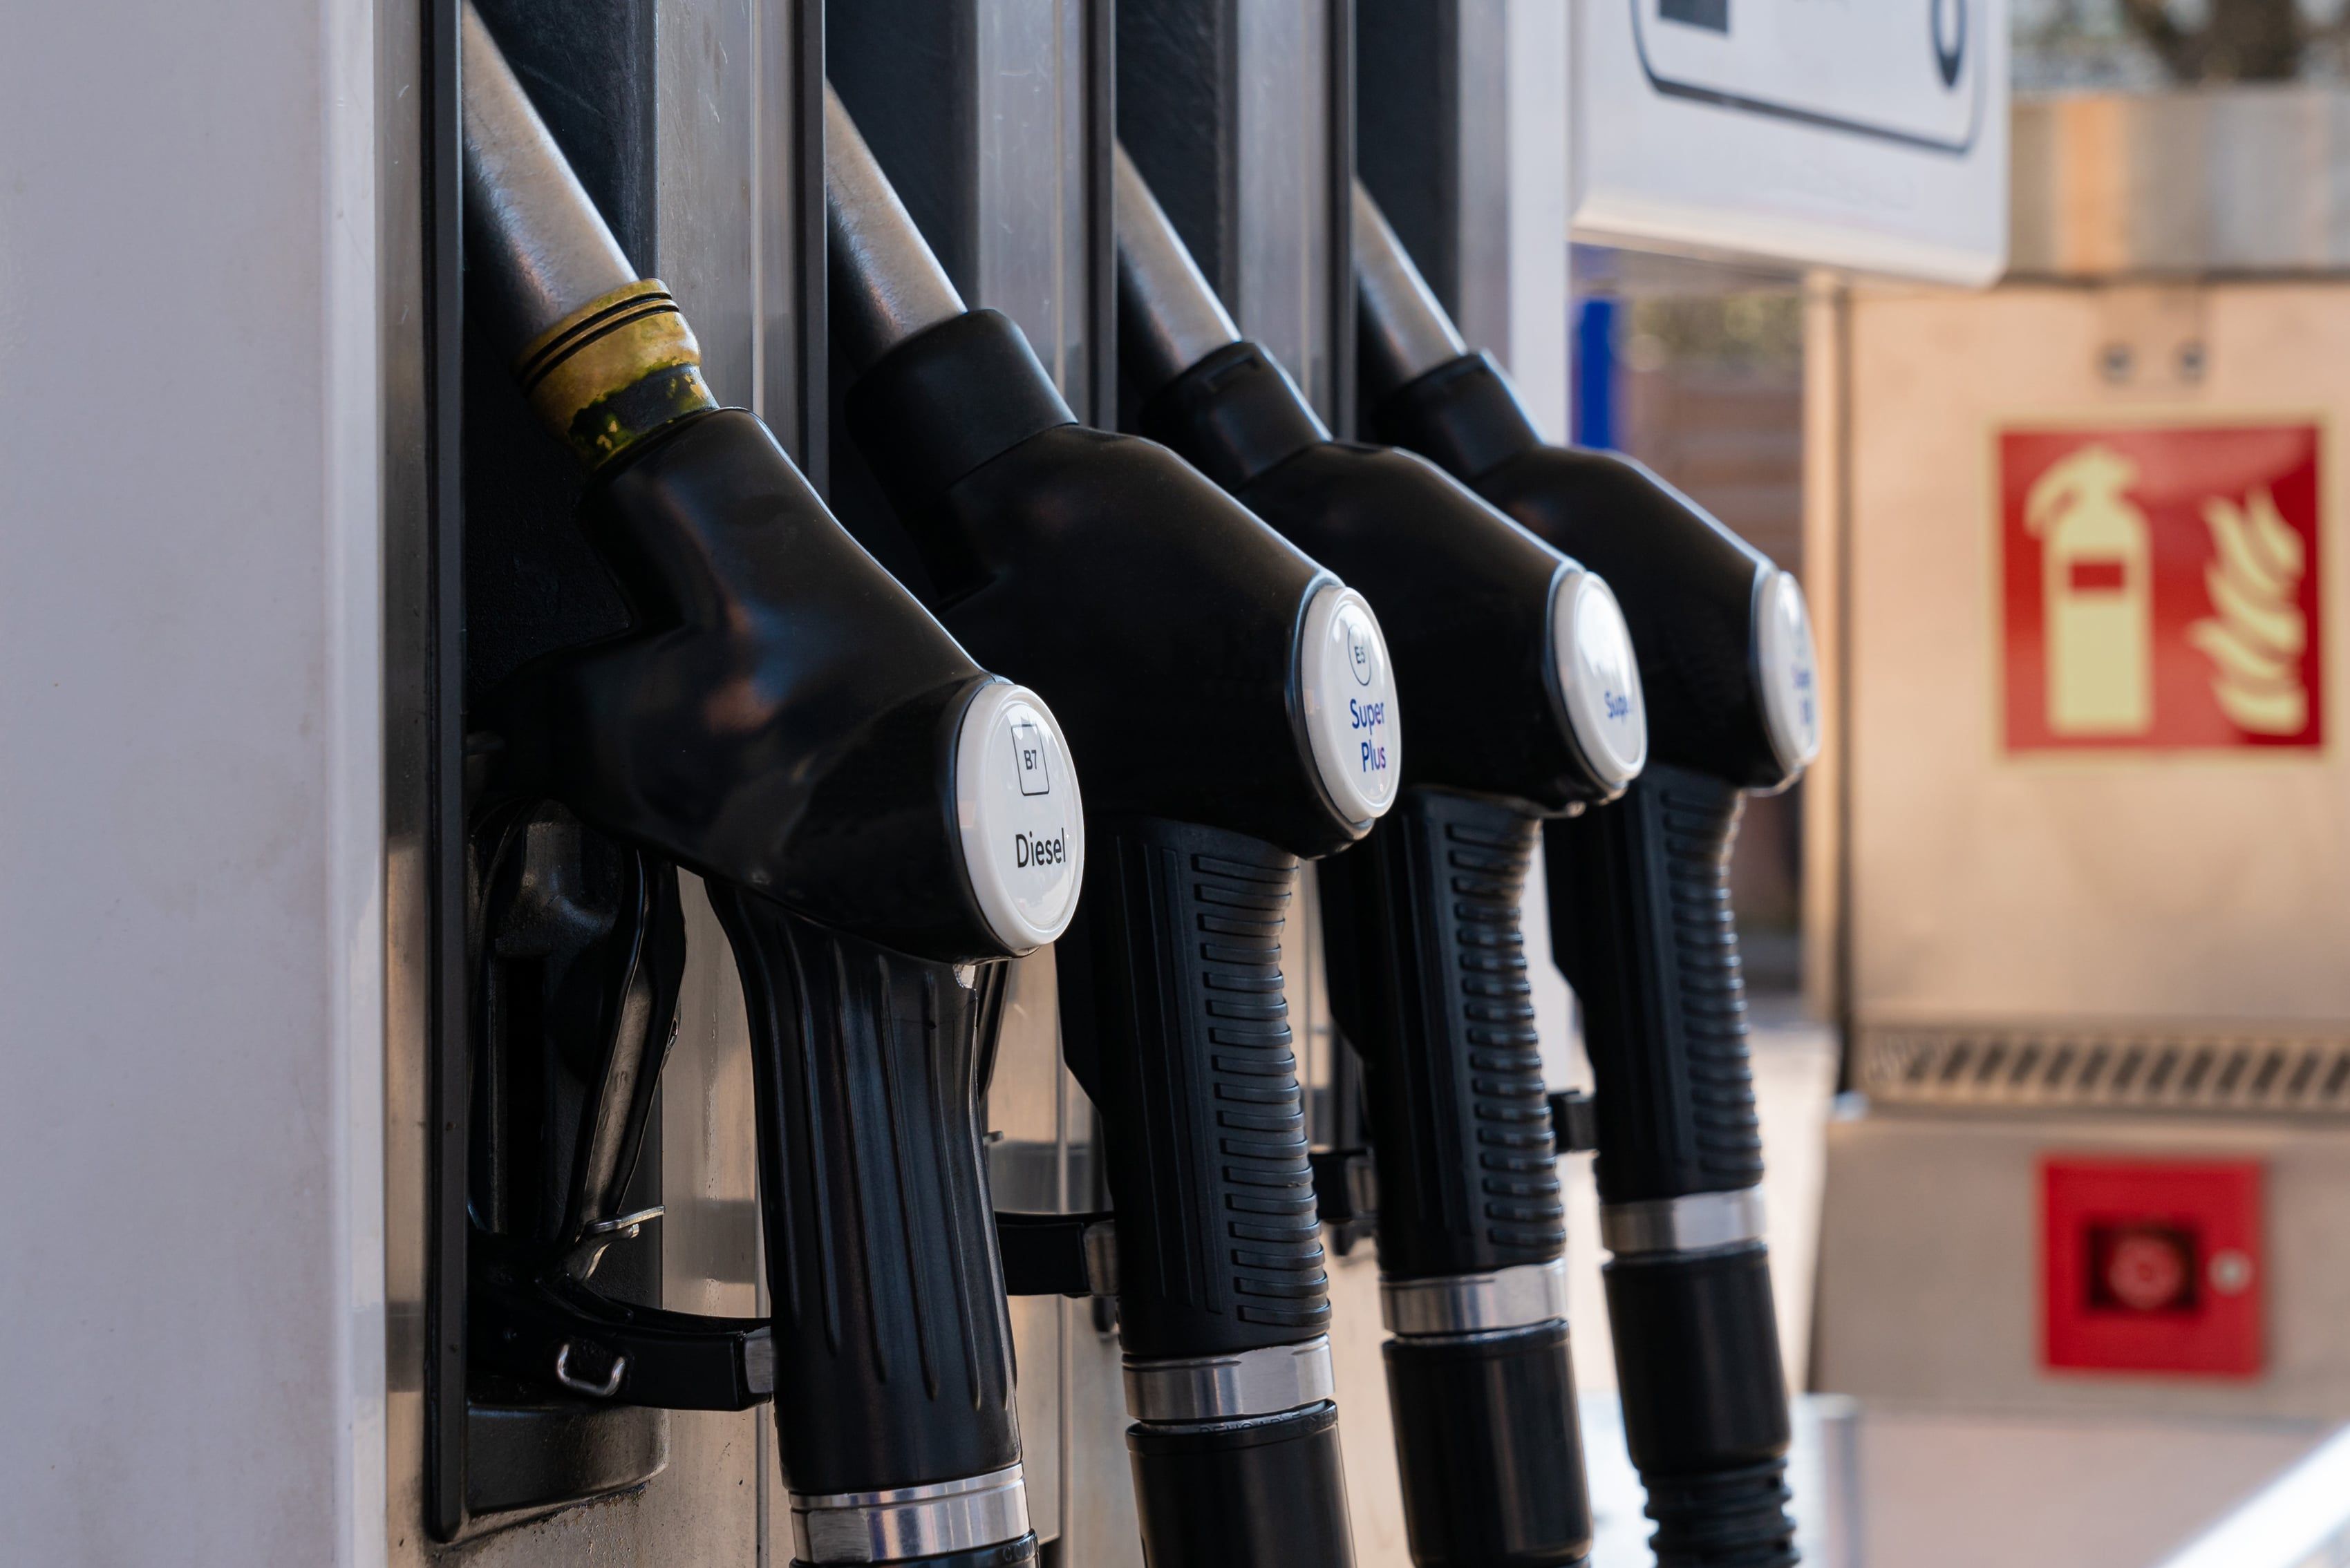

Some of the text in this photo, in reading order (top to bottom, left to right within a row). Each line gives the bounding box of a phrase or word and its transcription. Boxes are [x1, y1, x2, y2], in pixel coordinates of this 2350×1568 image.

[1354, 646, 1365, 663] E5
[1350, 699, 1384, 735] Super
[1024, 749, 1038, 770] B7
[1361, 739, 1386, 772] Plus
[1015, 828, 1066, 868] Diesel
